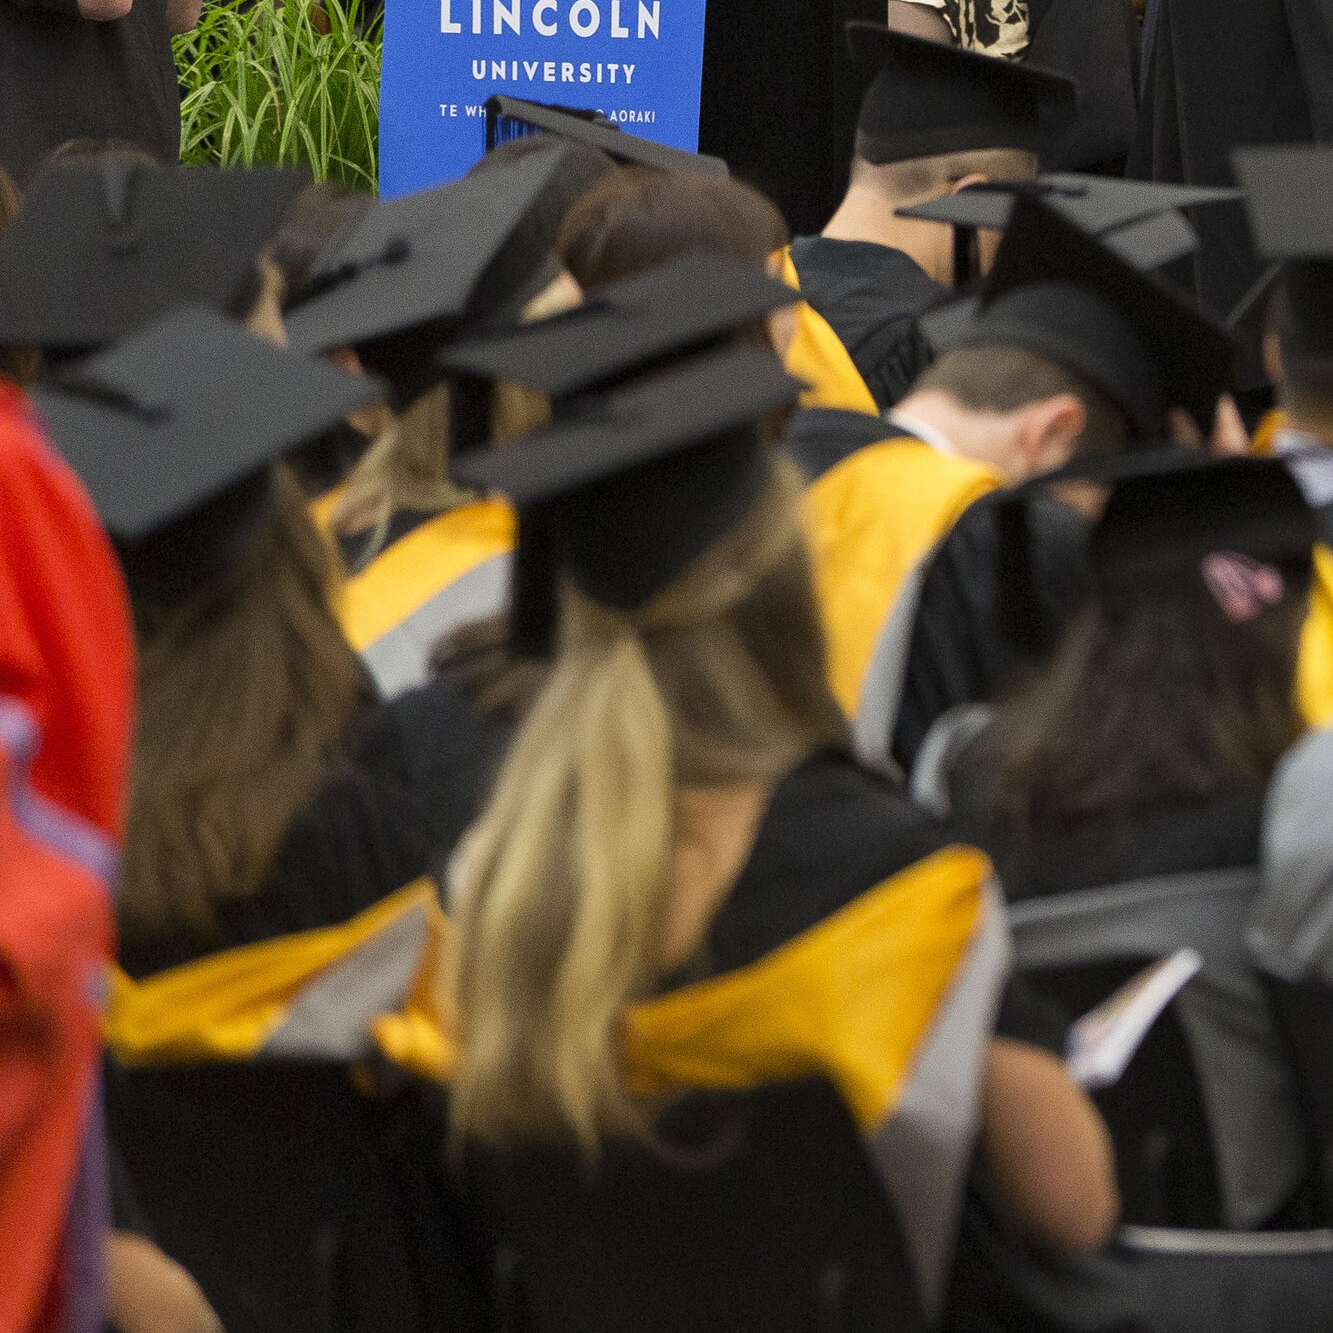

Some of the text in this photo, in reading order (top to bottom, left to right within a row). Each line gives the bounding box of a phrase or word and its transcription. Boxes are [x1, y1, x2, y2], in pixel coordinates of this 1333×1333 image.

[472, 59, 636, 84] UNIVERSITY
[440, 104, 457, 117] TE
[465, 105, 487, 118] WH
[610, 109, 656, 123] AORAKI
